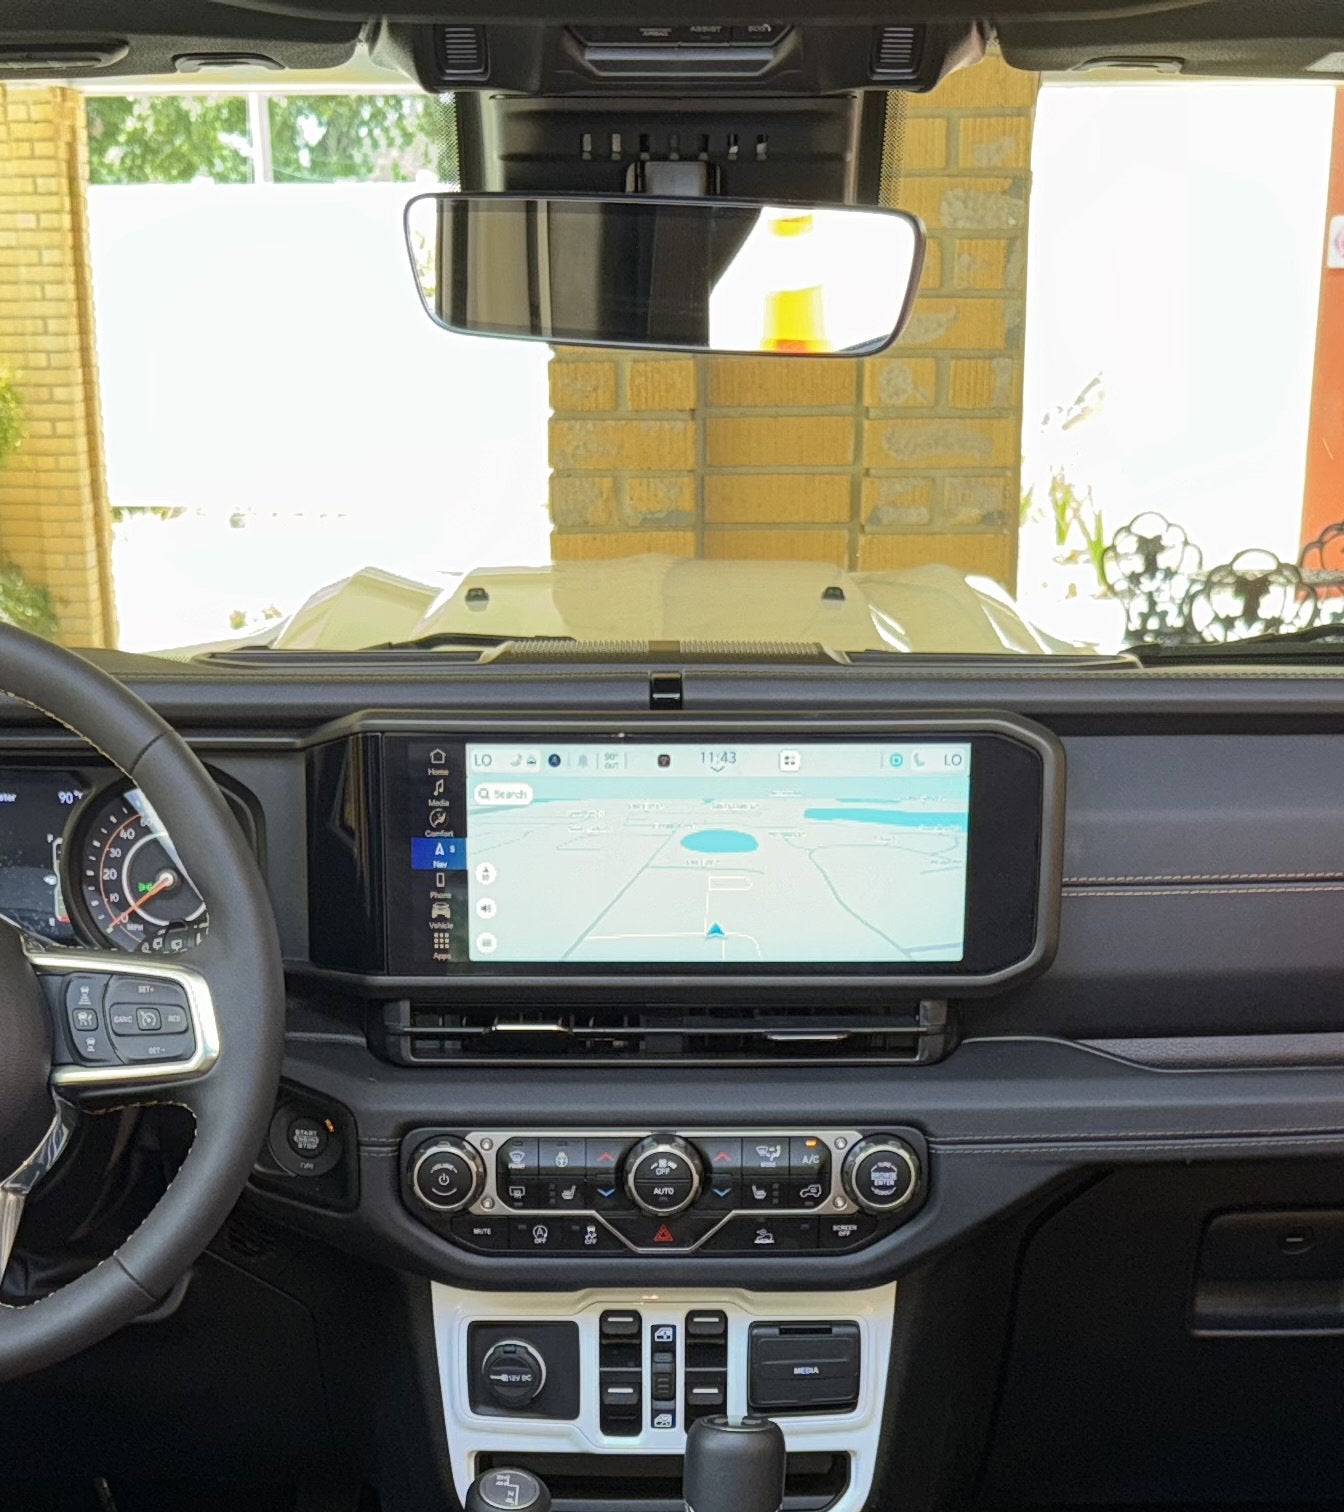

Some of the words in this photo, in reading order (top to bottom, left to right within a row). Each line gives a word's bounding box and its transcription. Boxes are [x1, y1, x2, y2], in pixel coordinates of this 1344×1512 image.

[474, 754, 492, 767] LO
[700, 751, 737, 764] 11:43
[944, 754, 962, 766] LO
[428, 768, 449, 776] Home
[494, 789, 526, 799] Search
[428, 799, 450, 807] Media
[119, 828, 136, 839] 40
[424, 830, 454, 838] Comfort
[109, 847, 121, 858] 30
[433, 861, 448, 869] Nav
[103, 868, 117, 880] 20
[109, 893, 120, 902] 10
[429, 922, 453, 930] Vehicle
[433, 952, 451, 961] Apps
[802, 1155, 820, 1164] A/C
[656, 1167, 671, 1176] OFF
[653, 1187, 674, 1195] AUTO
[793, 1366, 819, 1375] MEDIA
